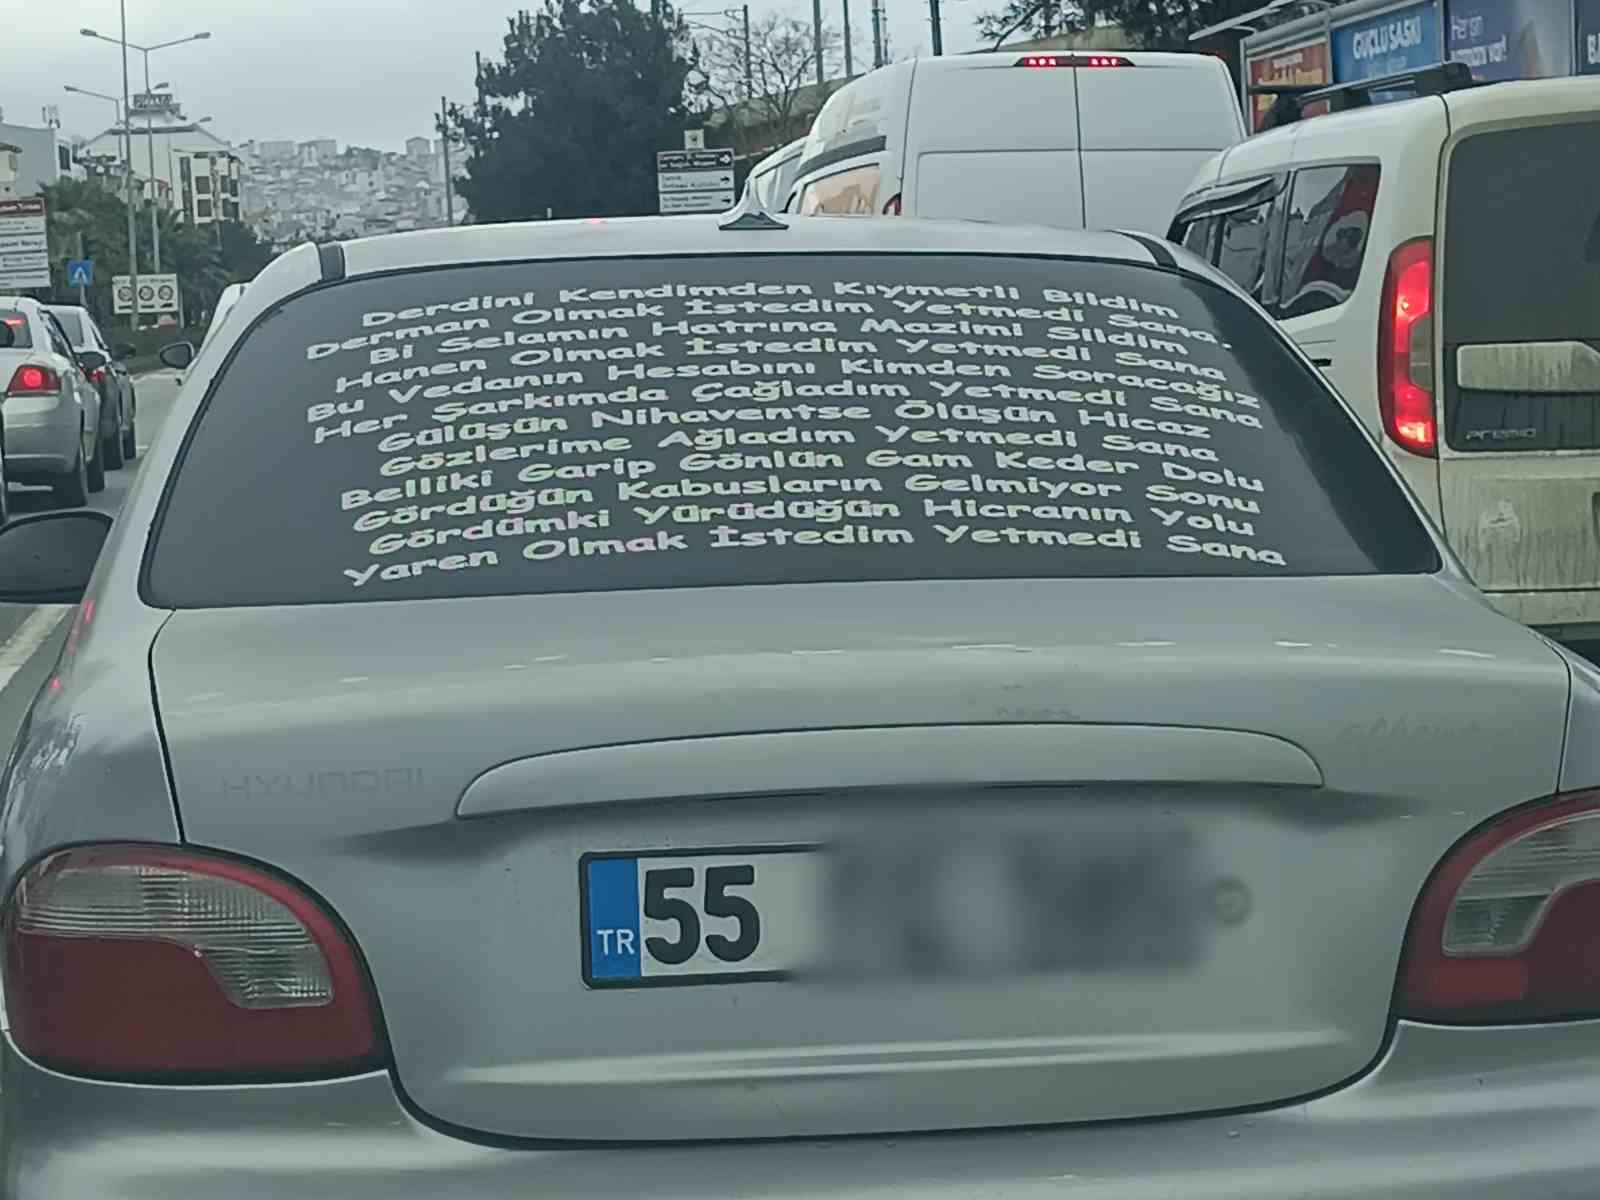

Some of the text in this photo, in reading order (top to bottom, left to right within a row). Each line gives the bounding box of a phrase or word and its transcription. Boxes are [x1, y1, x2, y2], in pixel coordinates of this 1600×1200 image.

[307, 319, 489, 359] Derman
[512, 303, 664, 323] Olmak
[685, 299, 874, 314] İstedim
[893, 300, 1084, 322] Yetmedi
[363, 292, 533, 326] Derdini
[560, 283, 812, 302] Kendimden
[336, 338, 1226, 393] Hanen Olmak İstedim Yetmedi Sana
[370, 345, 413, 364] Bi
[438, 327, 629, 352] Selamın
[653, 320, 837, 336] Hatrına
[308, 359, 1260, 422] Bu Vedanın Hesabını Kimden Soracağız
[315, 414, 407, 443] Her
[692, 380, 910, 402] Çağladım
[929, 381, 1126, 406] Yetmedi
[1150, 397, 1263, 429] Sana
[378, 400, 1210, 452] Gülüşün Nihaventse Ölüşün Hicaz
[380, 426, 1219, 476] Gözlerime Ağladım Yetmedi Sana
[342, 450, 1264, 510] Belliki Garip Gönlün Gam Keder Dolu
[353, 474, 1260, 531] Gördüğün Kabusların Gelmiyor Sonu
[633, 499, 900, 524] Yürüdüğün
[924, 499, 1133, 523] Hicranın
[1150, 508, 1254, 535] Yolu
[344, 525, 1286, 586] Yaren Olmak İstedim Yetmedi Sana
[597, 929, 635, 956] TR
[644, 864, 761, 965] 55
